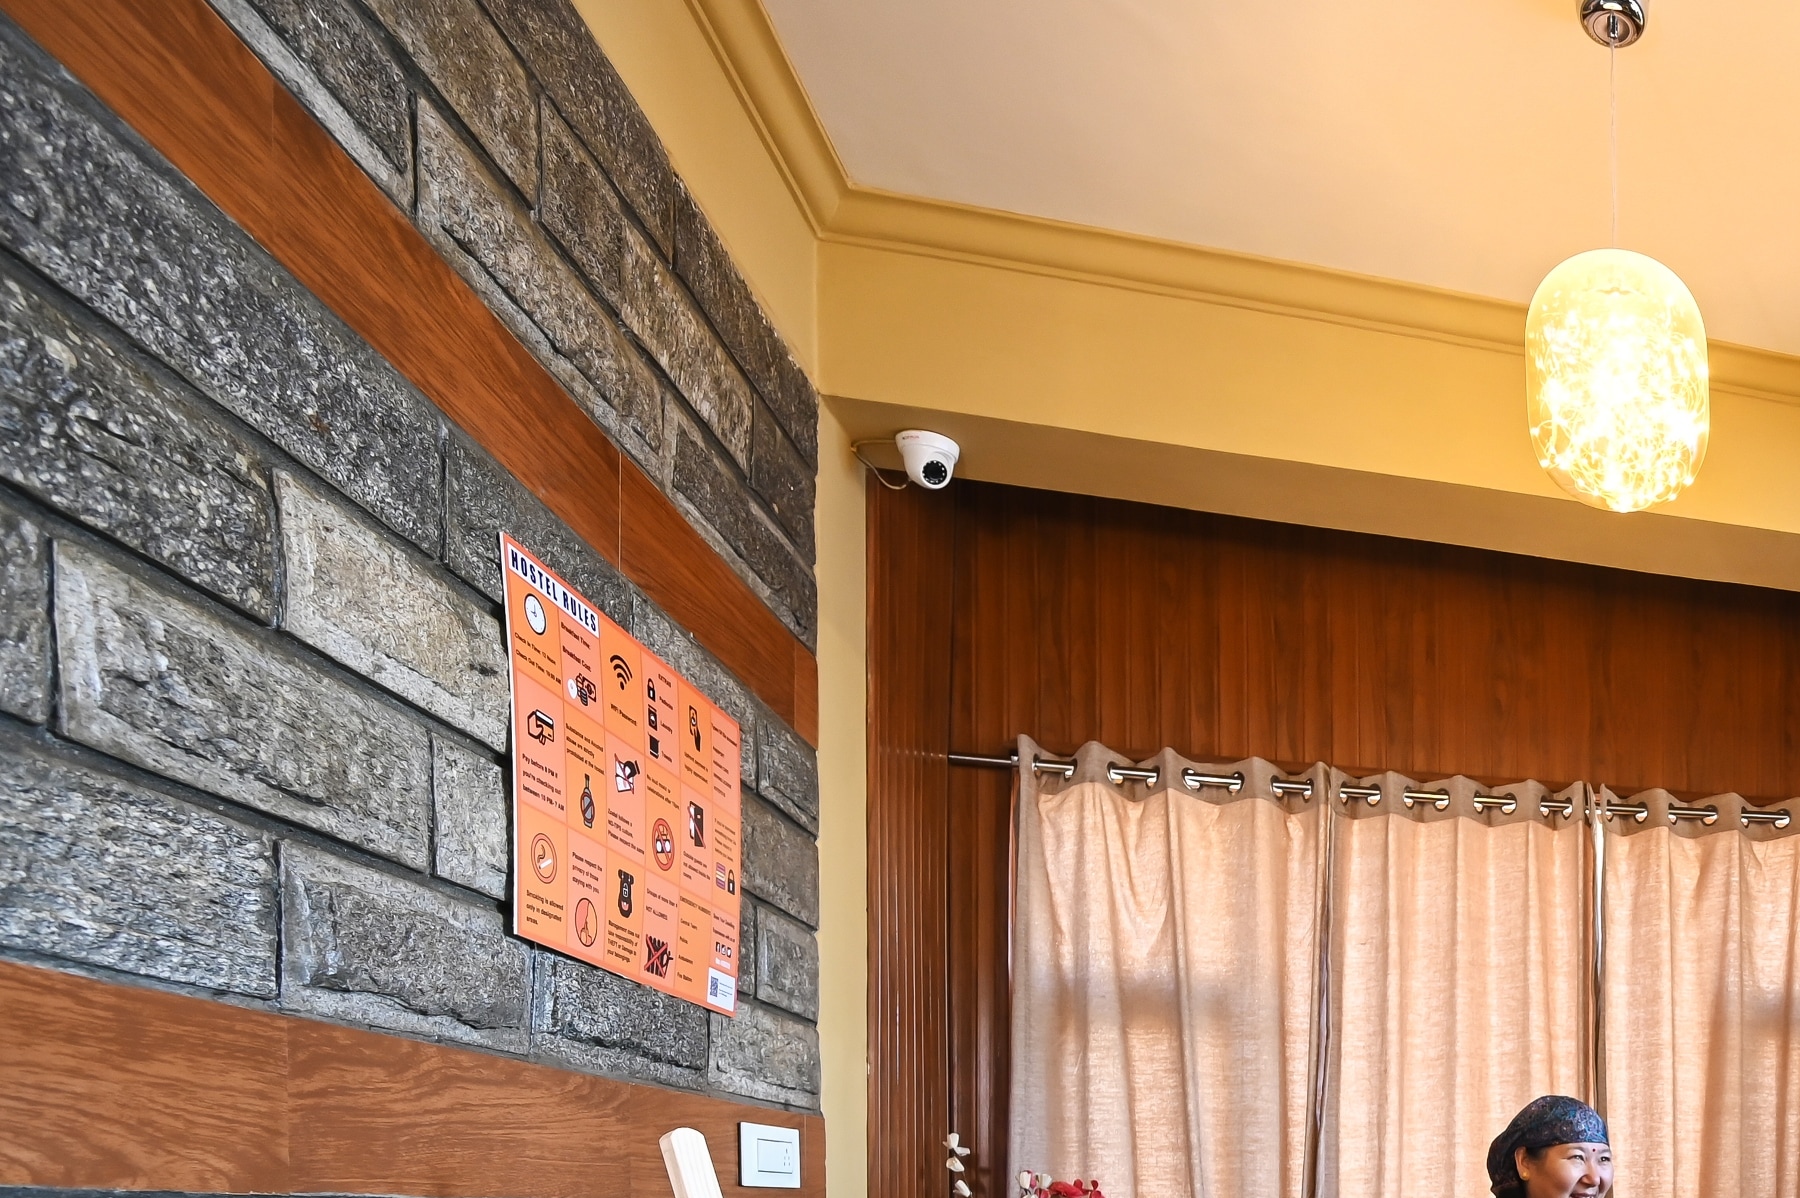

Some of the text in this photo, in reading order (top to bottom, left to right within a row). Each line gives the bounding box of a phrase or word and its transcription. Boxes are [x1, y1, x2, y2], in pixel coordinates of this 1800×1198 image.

[511, 548, 596, 632] HOSTEL RULES
[561, 621, 579, 641] Breakfast
[562, 645, 580, 664] Breakfast
[522, 753, 530, 764] Pay
[531, 758, 543, 771] before
[548, 768, 554, 777] PM
[522, 784, 539, 798] between
[536, 776, 554, 792] checking
[572, 851, 583, 862] Please
[584, 858, 596, 870] respect
[572, 876, 584, 888] staying
[526, 889, 544, 904] Smoking
[549, 899, 563, 911] allowed
[526, 902, 535, 912] only
[540, 908, 561, 922] designated
